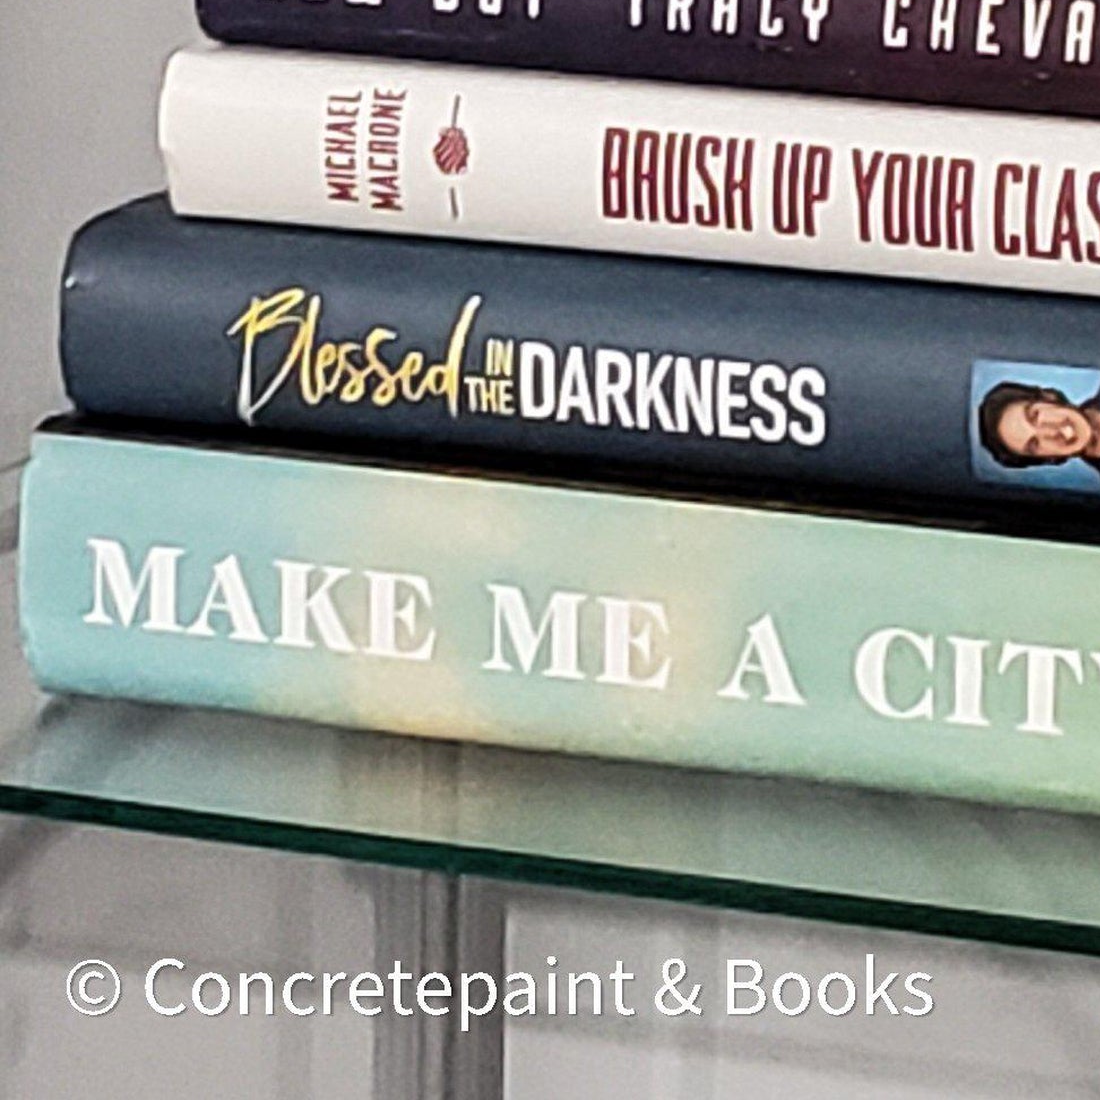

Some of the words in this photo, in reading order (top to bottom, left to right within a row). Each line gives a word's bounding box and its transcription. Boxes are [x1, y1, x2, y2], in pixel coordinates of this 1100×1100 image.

[324, 90, 362, 203] MICHAEL
[368, 87, 408, 212] MACRONE
[602, 126, 755, 232] BRUSH
[770, 142, 832, 238] UP
[851, 147, 975, 253] YOUR
[227, 287, 482, 427] Blessed
[463, 376, 516, 415] THE
[486, 337, 514, 377] IN
[519, 342, 827, 447] DARKNESS
[82, 537, 437, 662] MAKE
[481, 582, 673, 690] ME
[716, 611, 807, 706] A
